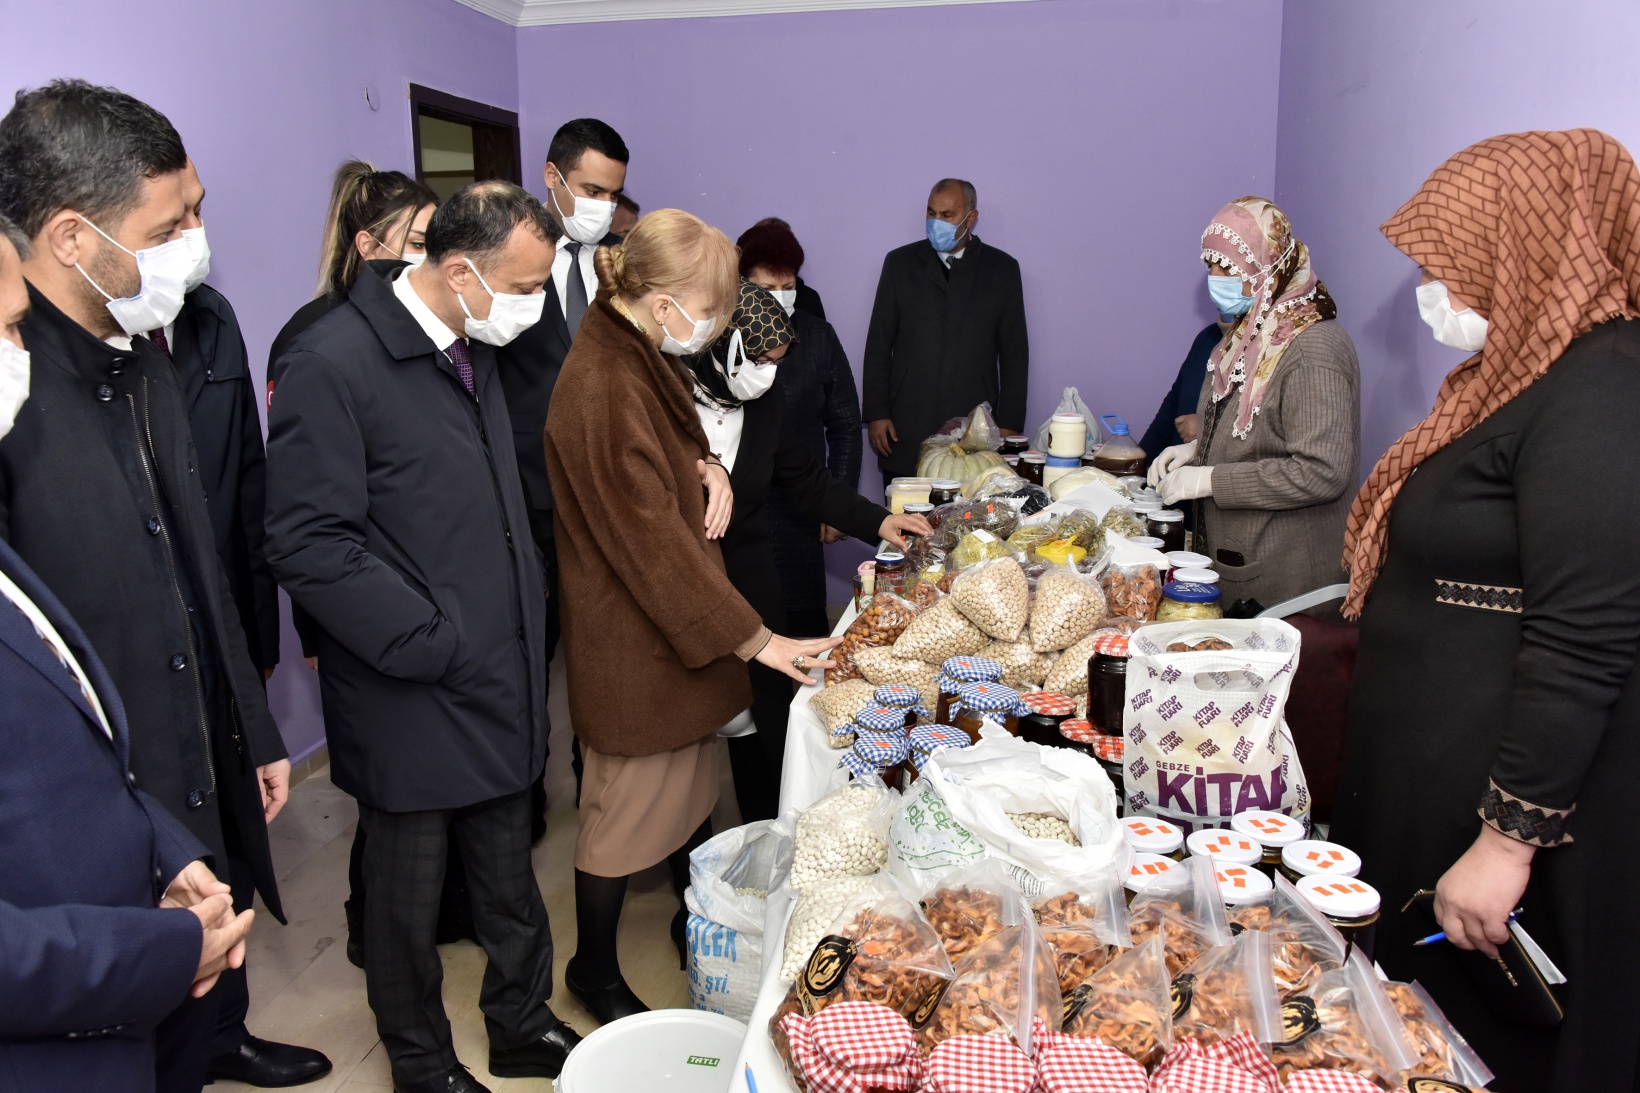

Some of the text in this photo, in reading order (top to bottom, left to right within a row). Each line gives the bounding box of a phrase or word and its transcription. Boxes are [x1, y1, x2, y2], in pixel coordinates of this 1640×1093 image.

[1130, 688, 1151, 705] KİTAP
[1156, 695, 1177, 715] KİTAP
[1161, 701, 1183, 721] FUARI
[1192, 701, 1215, 722] KİTAP
[1230, 701, 1251, 722] KİTAP
[1262, 694, 1277, 719] FUARI
[1198, 707, 1221, 728] FUARI
[1157, 730, 1177, 749] KİTAP
[1162, 736, 1184, 755] FUARI
[1195, 738, 1213, 754] KİTAP
[1232, 735, 1245, 759] KİTAP
[1200, 744, 1220, 759] FUARI
[1238, 740, 1254, 764] FUARI
[1129, 756, 1144, 773] KİTAP
[1133, 763, 1149, 780] FUARI
[1155, 760, 1190, 772] GEBZE
[705, 973, 730, 995] ŞTİ.
[690, 1056, 719, 1066] TATLI
